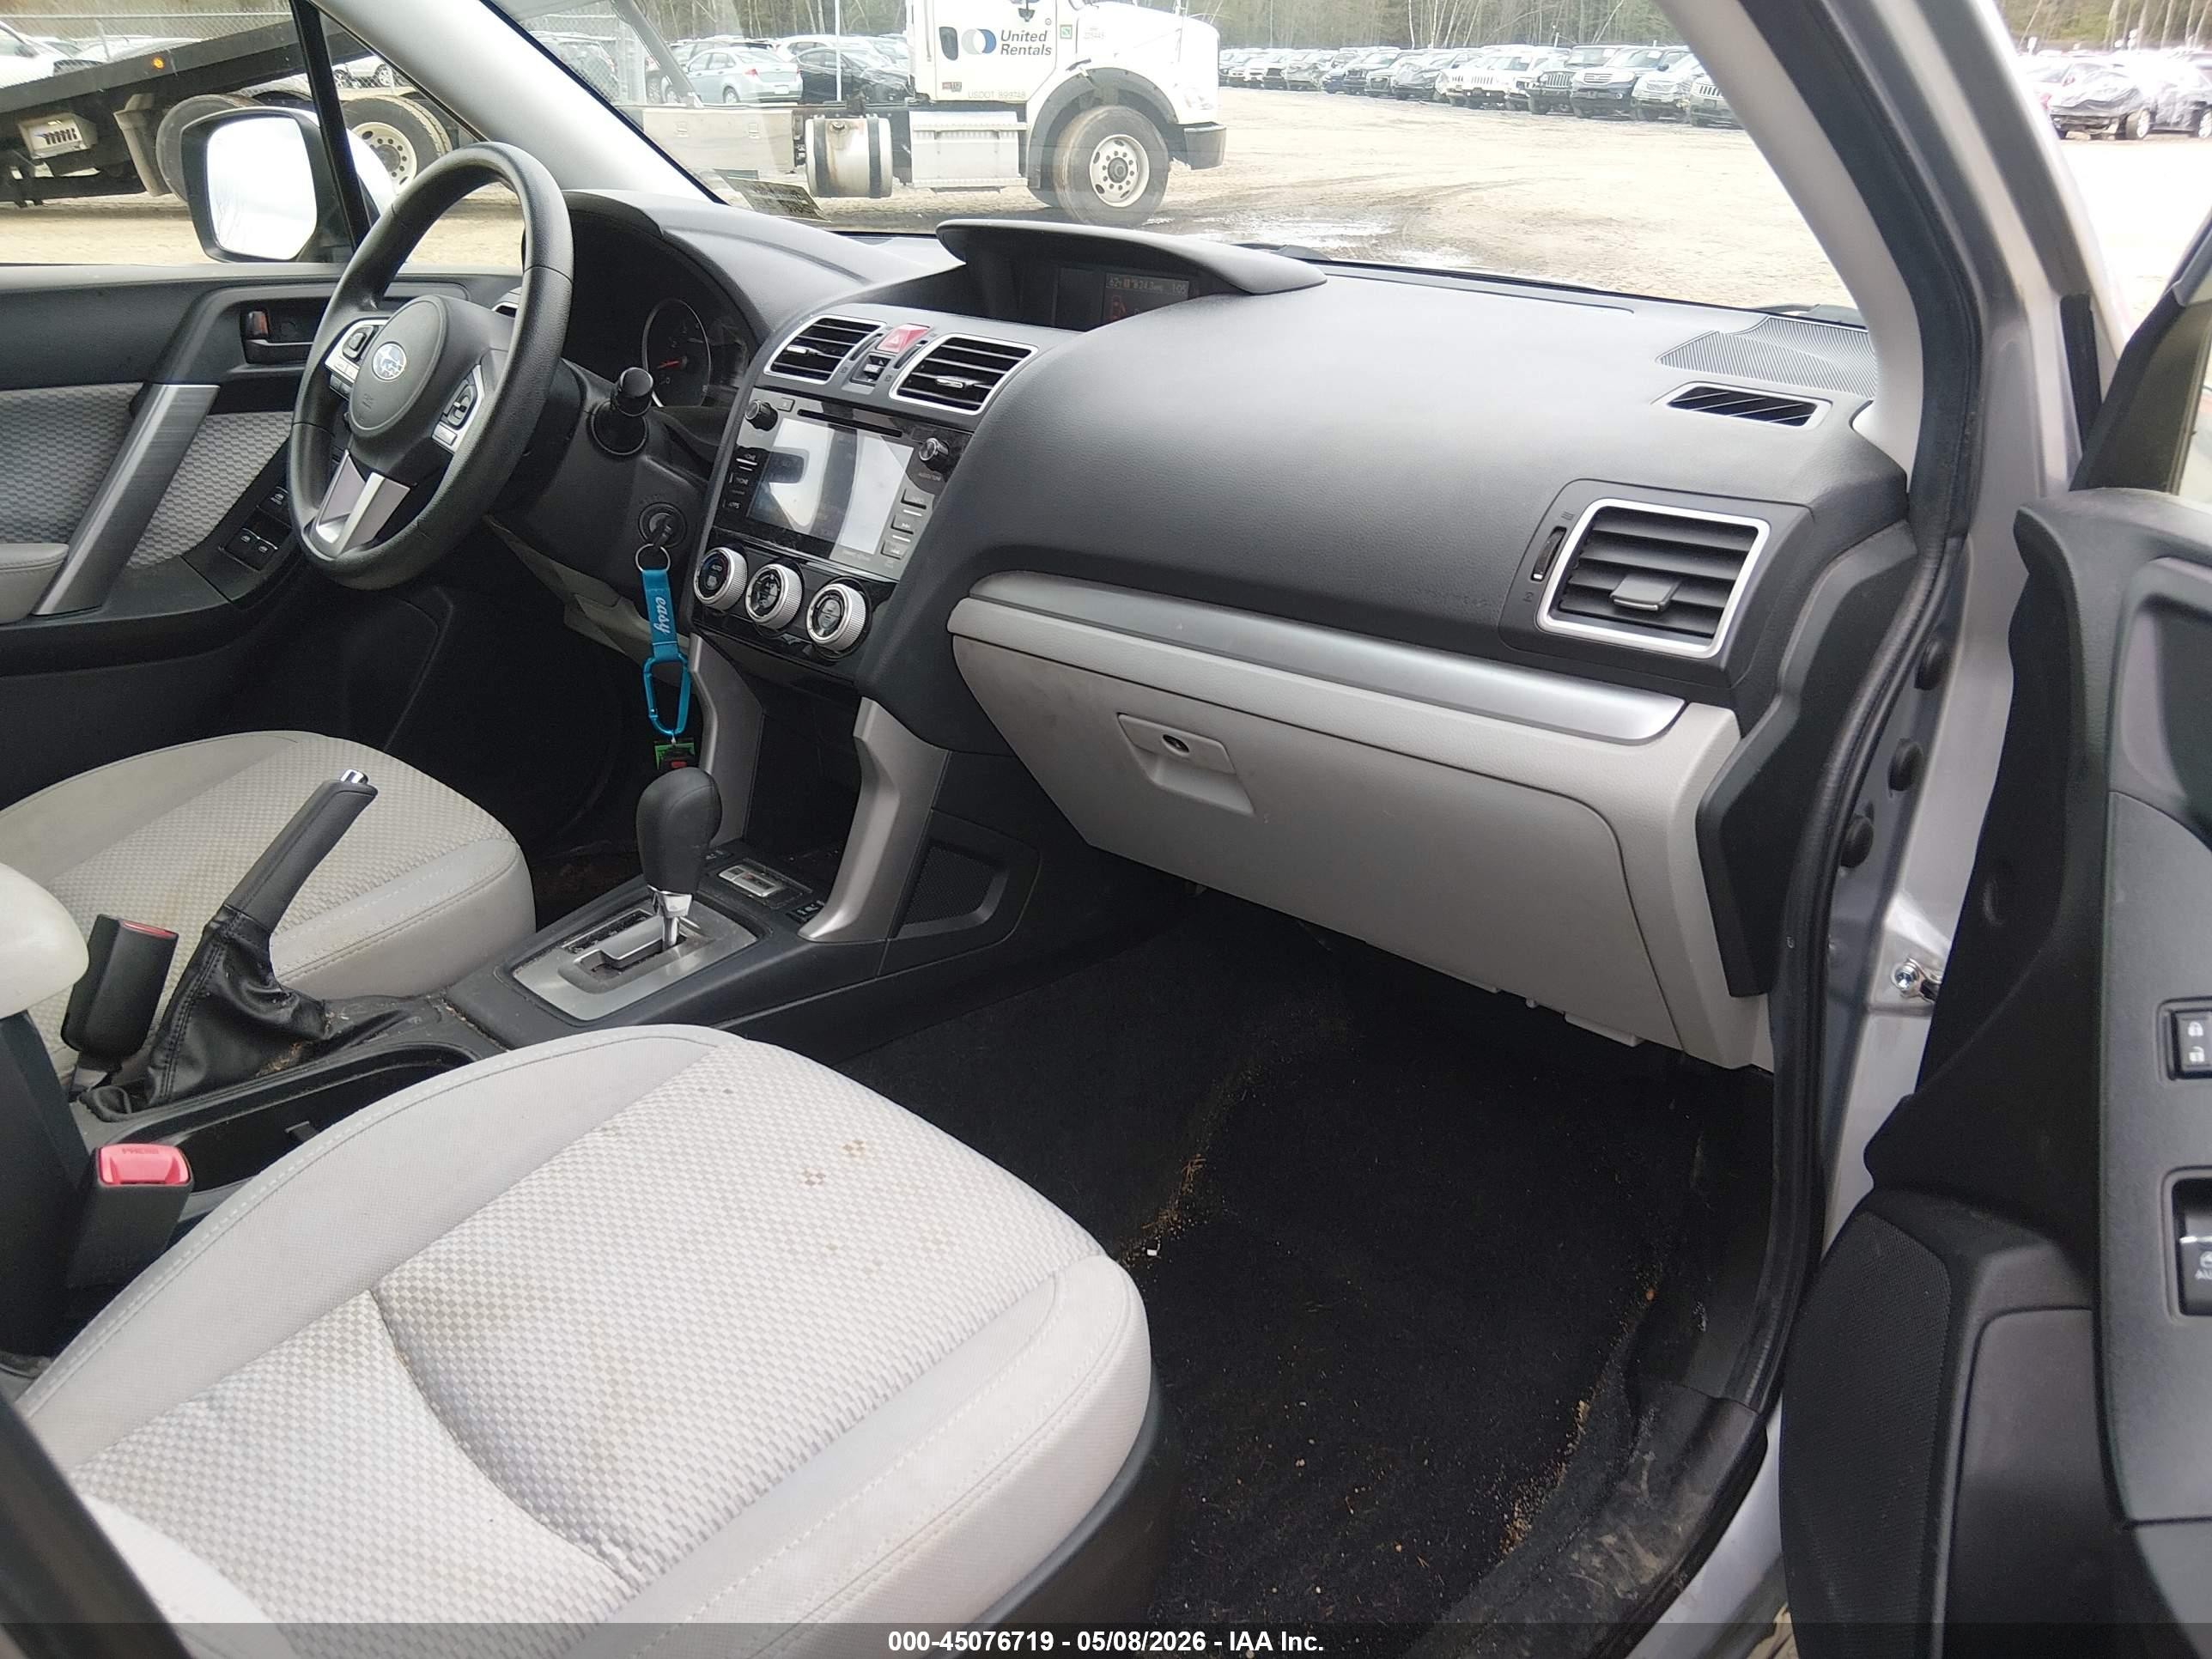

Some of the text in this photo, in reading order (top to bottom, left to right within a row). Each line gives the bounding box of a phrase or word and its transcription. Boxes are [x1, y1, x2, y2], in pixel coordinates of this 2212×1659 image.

[1000, 29, 1048, 42] United
[1000, 44, 1052, 56] Rentals
[968, 90, 995, 99] USDOT
[653, 596, 671, 634] easy
